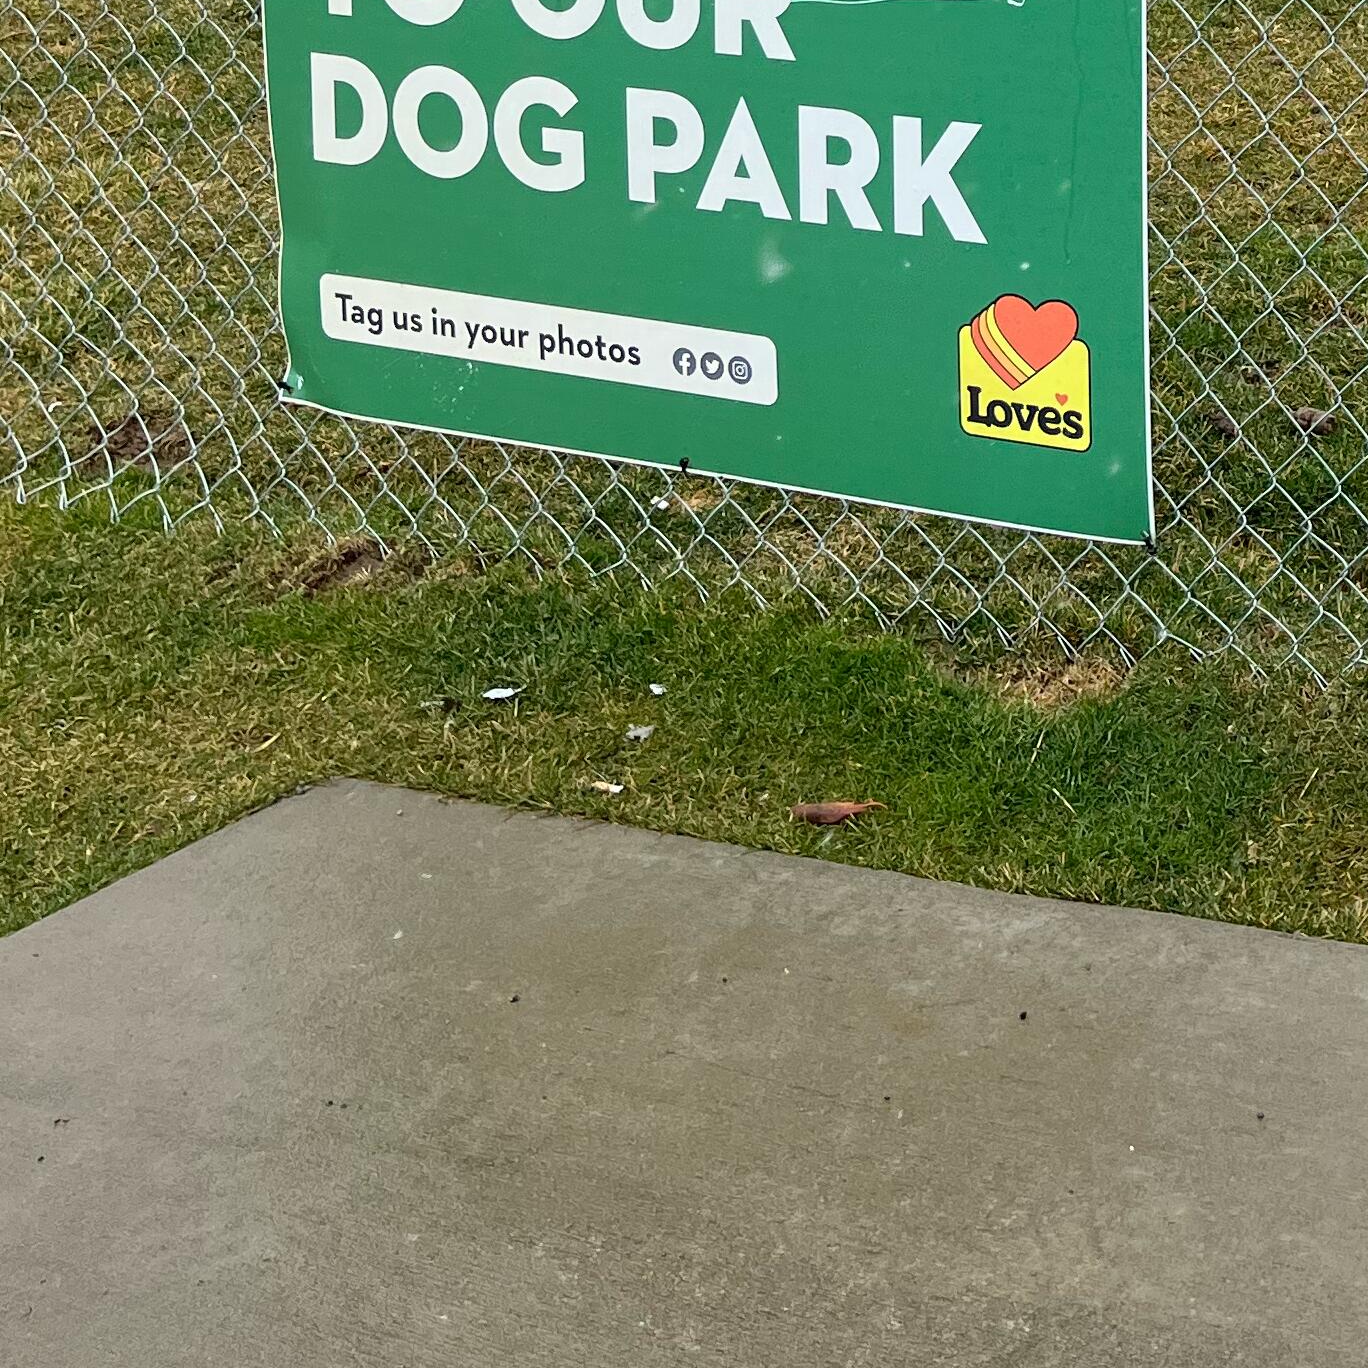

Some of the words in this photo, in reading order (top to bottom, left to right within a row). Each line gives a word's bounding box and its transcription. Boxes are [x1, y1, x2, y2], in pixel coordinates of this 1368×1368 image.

[310, 52, 585, 192] DOG
[625, 87, 988, 244] PARK
[334, 292, 383, 335] Tag
[393, 311, 423, 333] us
[431, 307, 456, 338] in
[464, 321, 529, 349] your
[539, 323, 641, 366] photos
